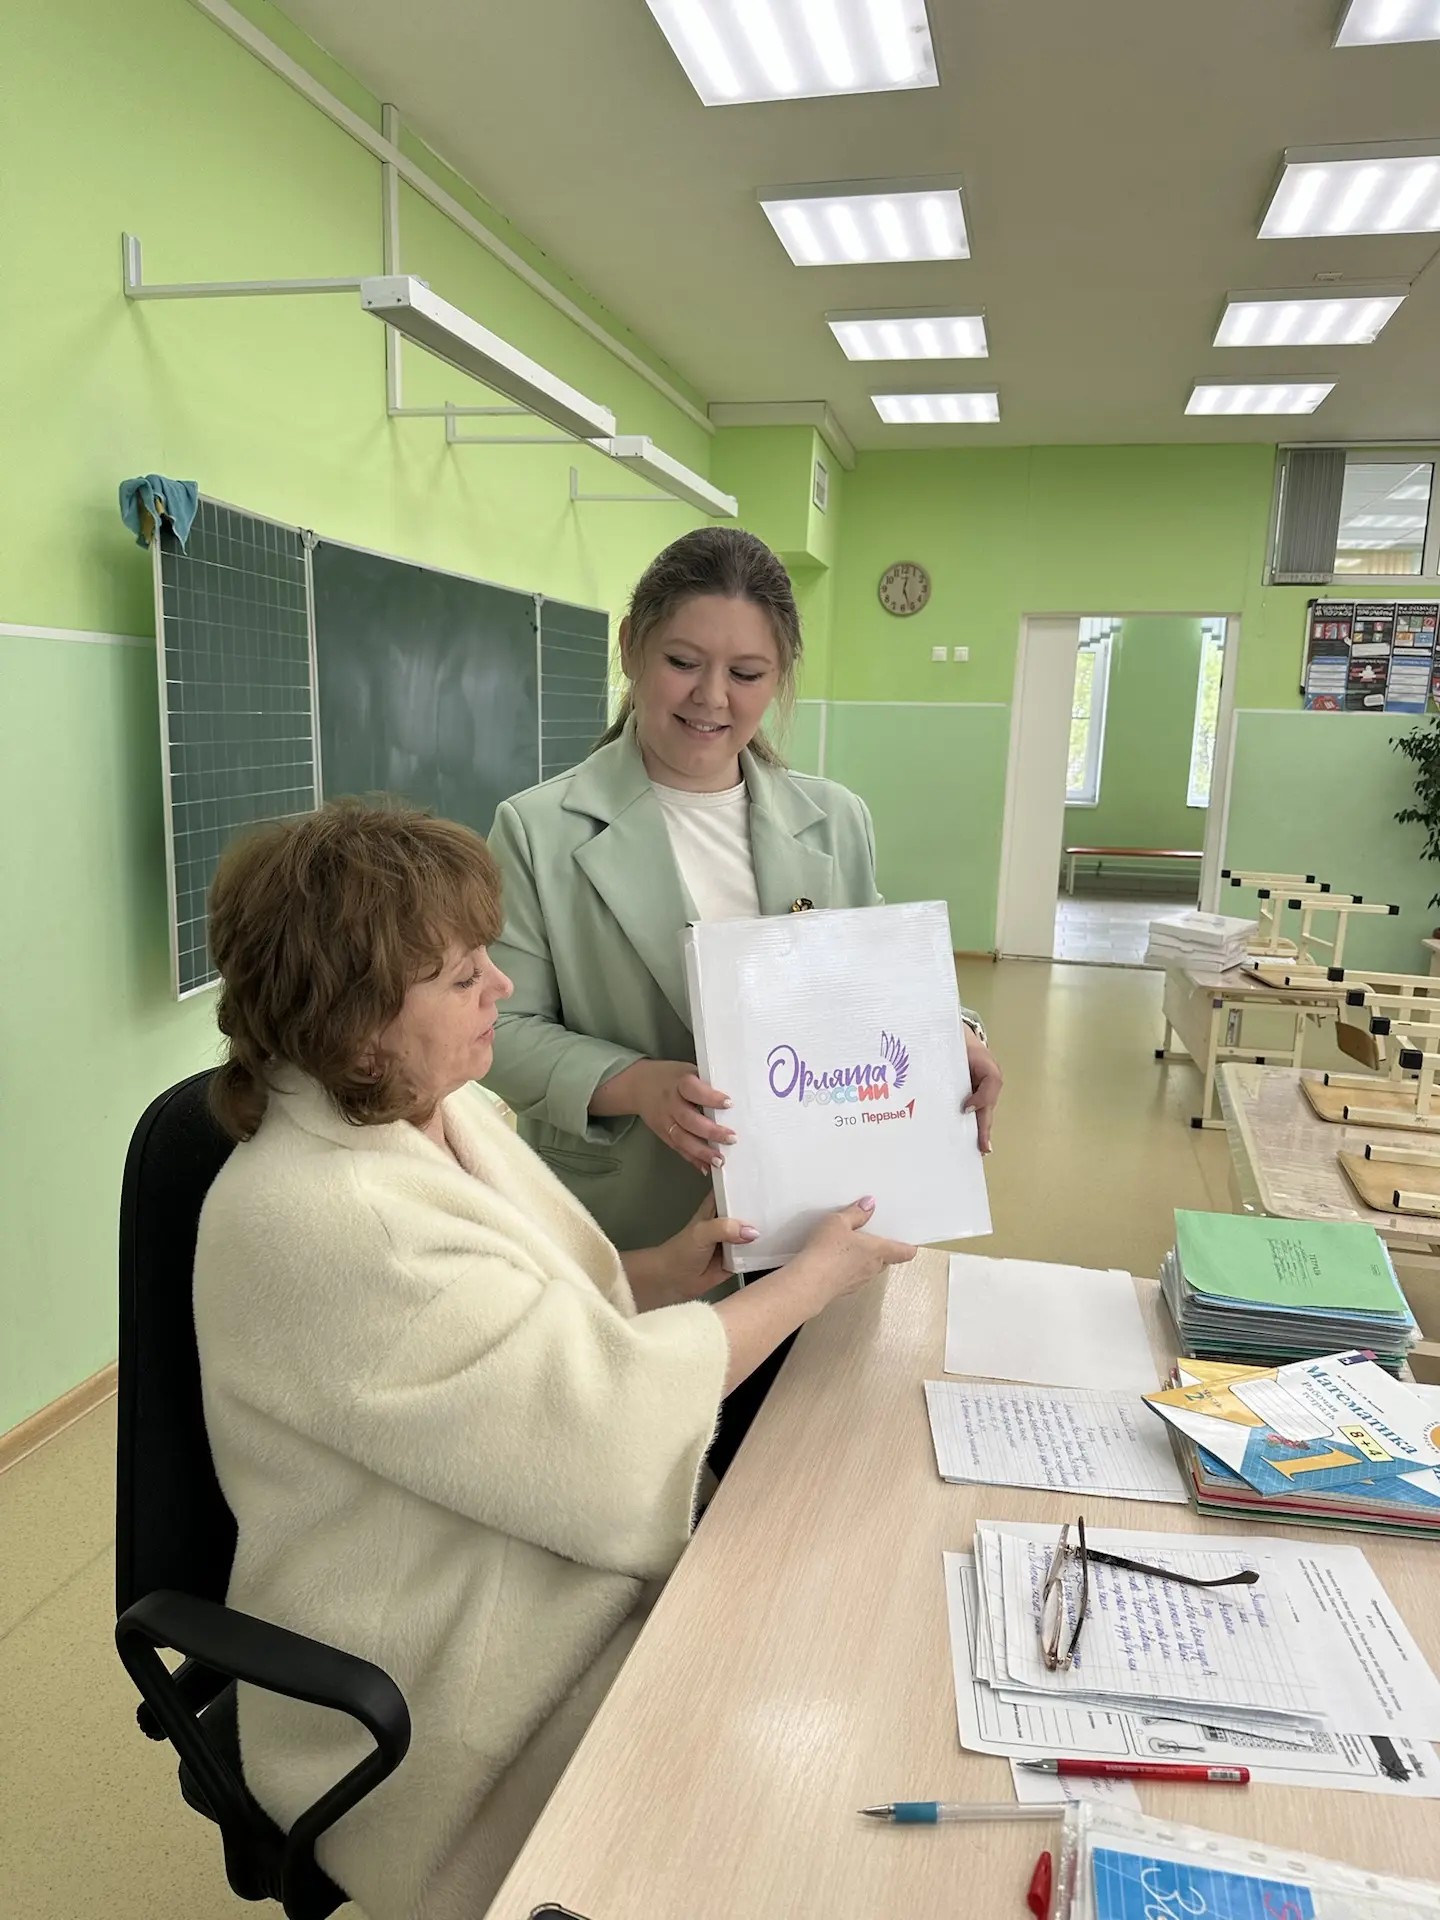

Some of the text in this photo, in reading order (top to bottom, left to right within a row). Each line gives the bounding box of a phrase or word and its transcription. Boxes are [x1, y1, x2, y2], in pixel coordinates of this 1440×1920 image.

[766, 1044, 888, 1102] Орлята
[834, 1108, 907, 1127] Это Первые
[1184, 1391, 1205, 1401] 2
[1301, 1381, 1339, 1413] Рабочая
[1302, 1391, 1335, 1420] тетрадь
[1302, 1365, 1419, 1455] Математика
[1260, 1445, 1362, 1482] 1
[1369, 1448, 1383, 1456] 4
